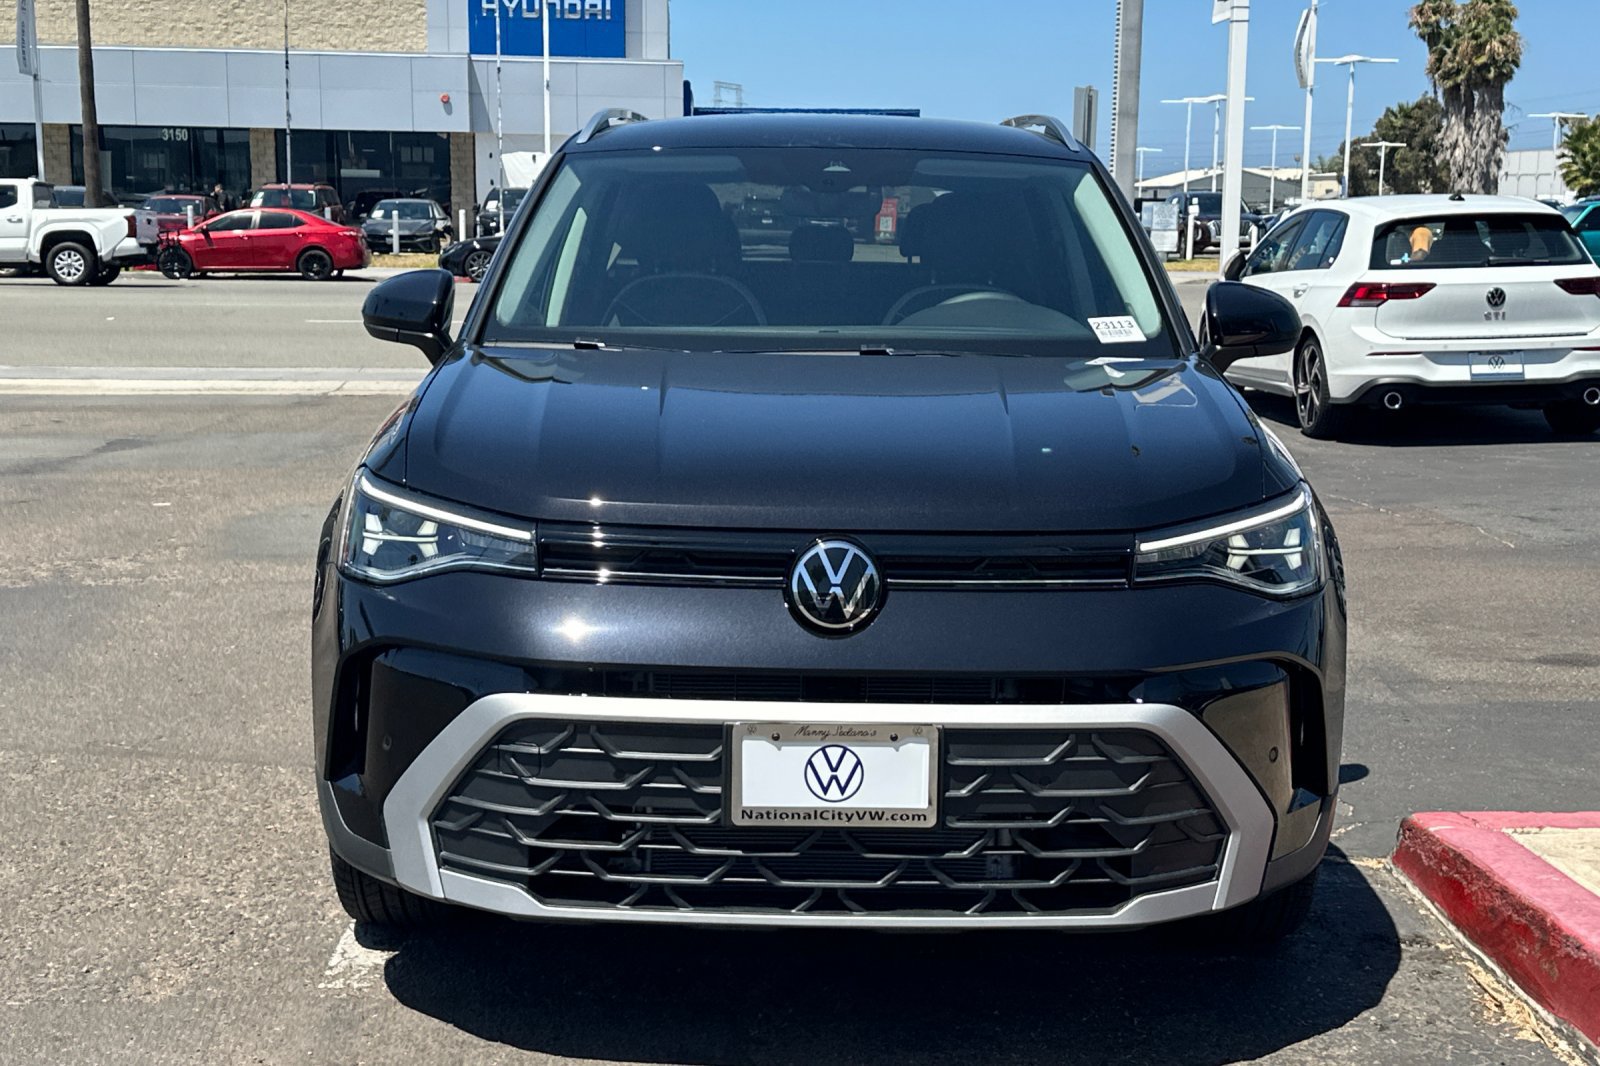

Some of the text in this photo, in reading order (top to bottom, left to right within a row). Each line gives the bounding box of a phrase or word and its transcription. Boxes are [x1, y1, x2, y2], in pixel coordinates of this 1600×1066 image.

[162, 128, 188, 141] 3150
[1093, 320, 1134, 330] 23113
[792, 540, 879, 628] VW
[794, 725, 830, 741] Manny
[804, 744, 864, 802] VW
[741, 809, 927, 823] NationalCityVW.com
